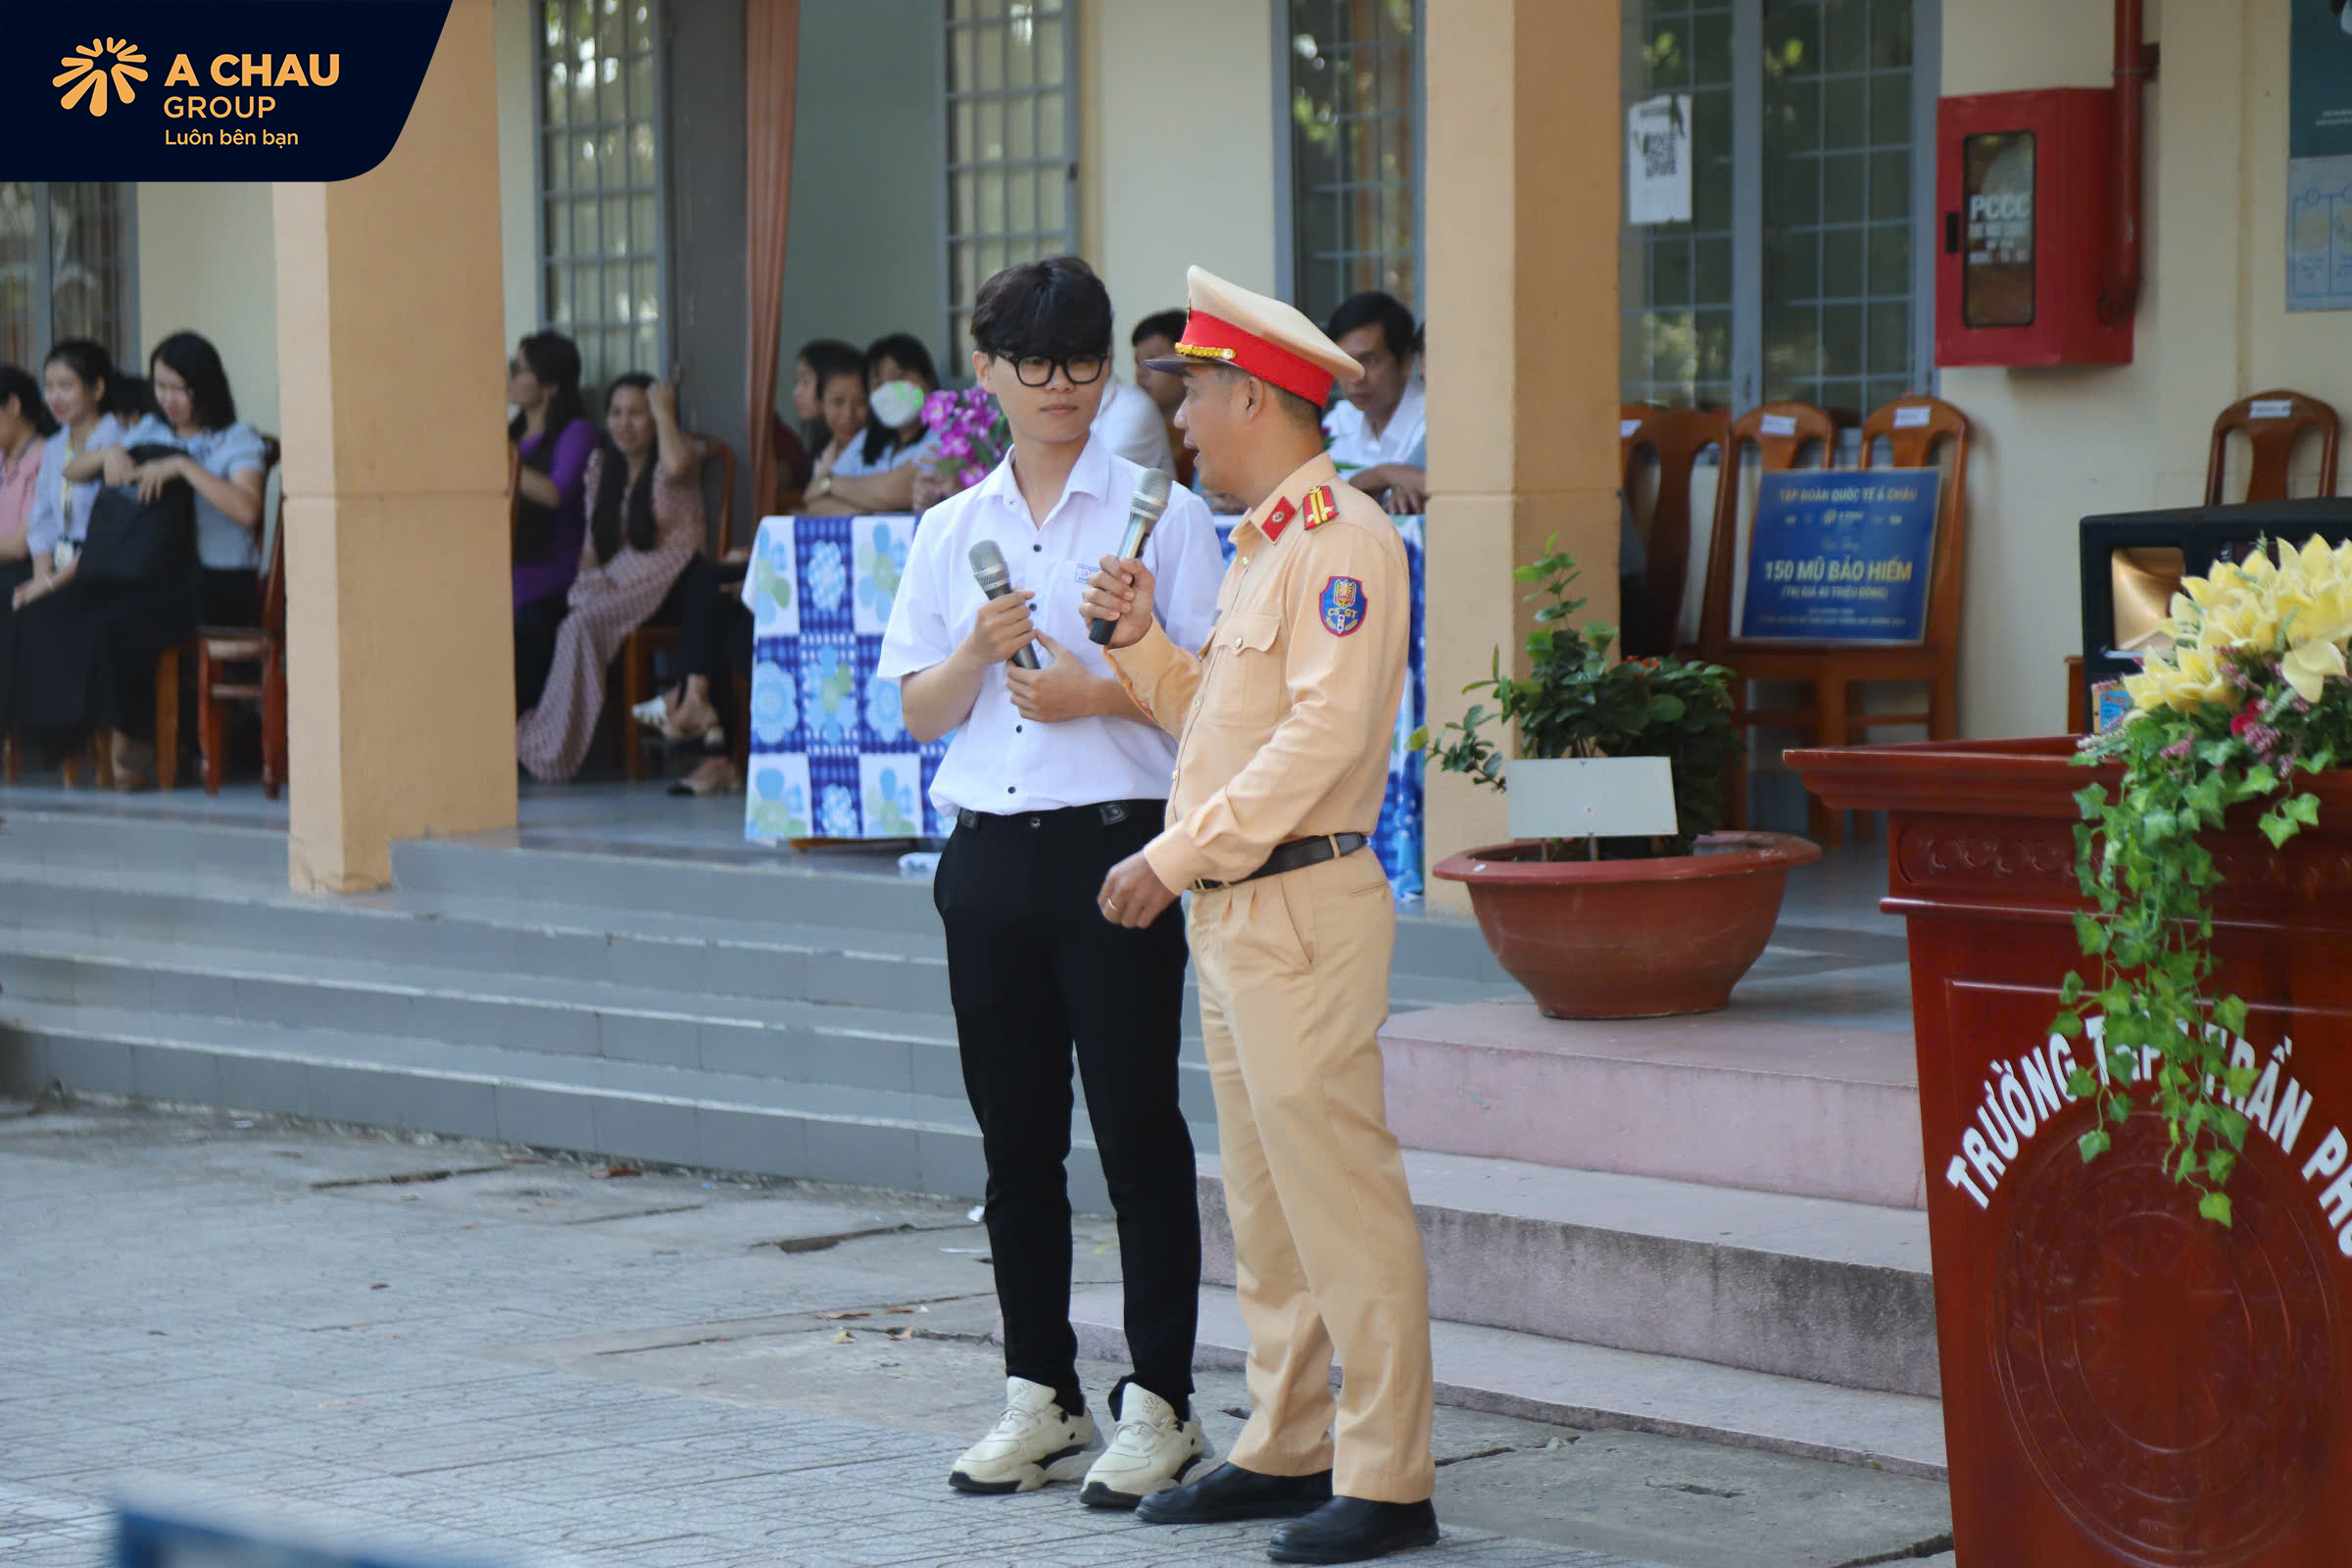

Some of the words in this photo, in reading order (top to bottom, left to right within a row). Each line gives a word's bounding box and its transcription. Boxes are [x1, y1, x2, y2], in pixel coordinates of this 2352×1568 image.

[1970, 194, 2031, 220] PCCC
[1765, 560, 1794, 581] 150
[1797, 556, 1826, 581] MŨ
[1828, 555, 1865, 581] BẢO
[1867, 555, 1913, 581] HIỂM
[1946, 1032, 2078, 1209] TRƯỜNG
